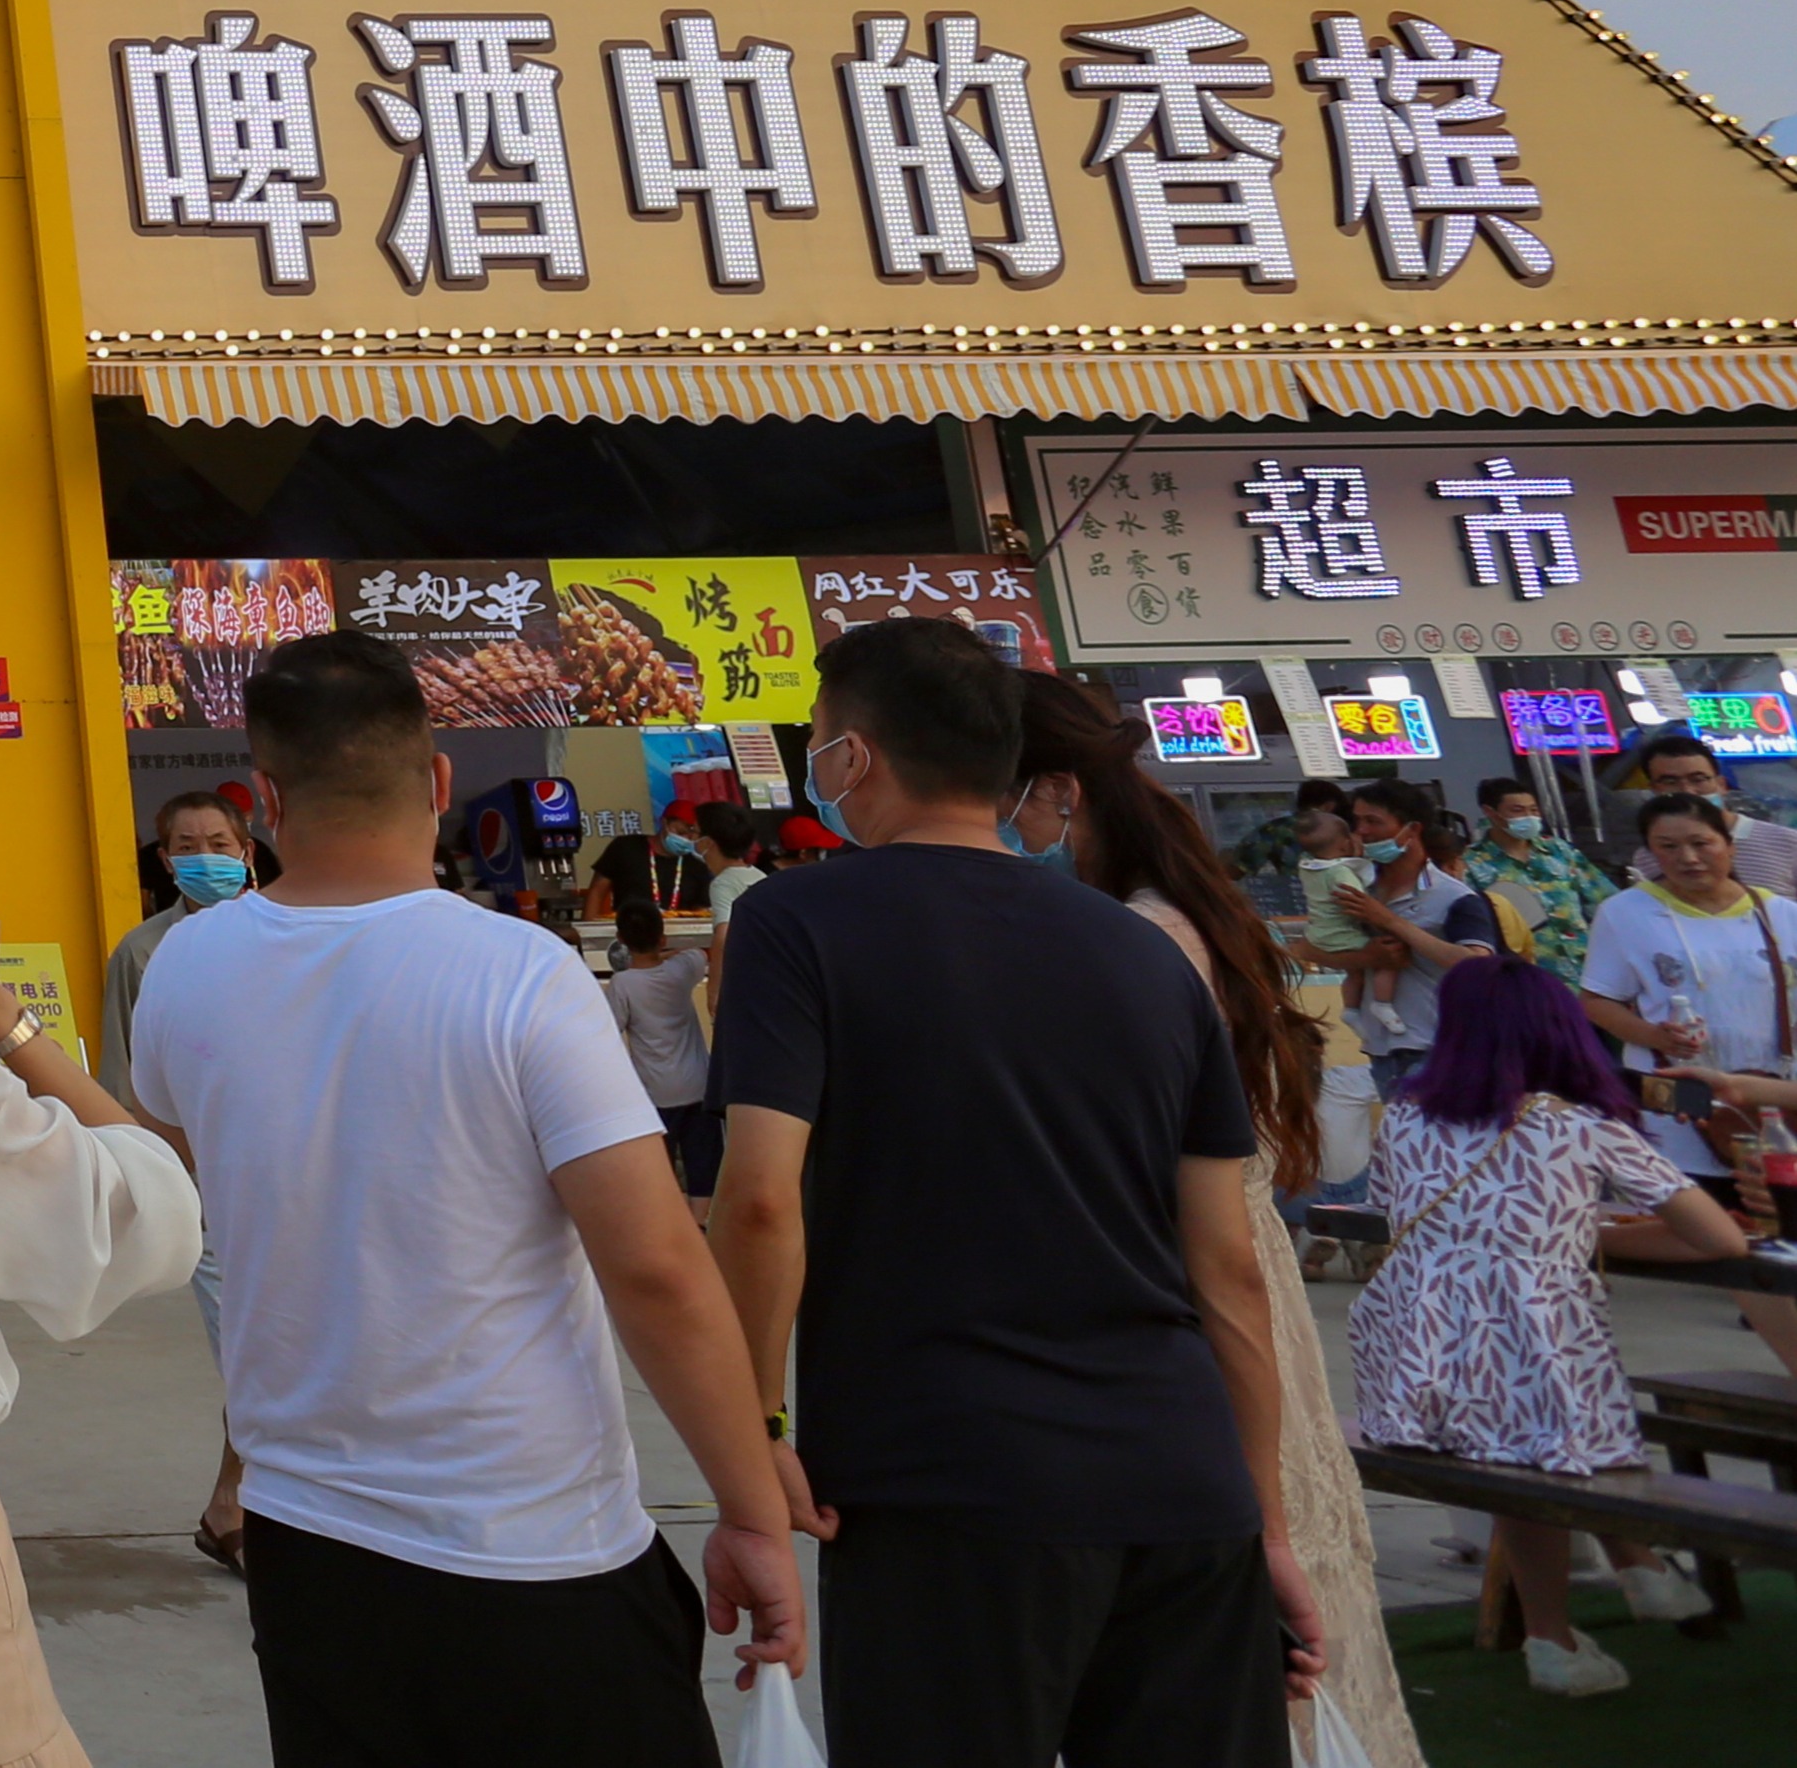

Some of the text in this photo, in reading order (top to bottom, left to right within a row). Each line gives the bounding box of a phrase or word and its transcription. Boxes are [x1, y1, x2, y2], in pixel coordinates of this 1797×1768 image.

[115, 9, 1556, 290] 啤酒中的香槟
[1067, 474, 1112, 577] 纪念品
[1237, 456, 1580, 600] 超市
[1637, 510, 1797, 540] SUPERM
[813, 562, 1031, 603] 网红大可乐
[182, 581, 330, 649] 深海章鱼脚
[349, 569, 546, 630] 羊肉大串
[1153, 703, 1222, 735] 冷饮
[1334, 701, 1401, 734] 零食
[1687, 697, 1759, 729] 鲜果
[1160, 736, 1188, 755] cold
[1341, 735, 1416, 756] Snacks
[542, 811, 570, 823] pepsi
